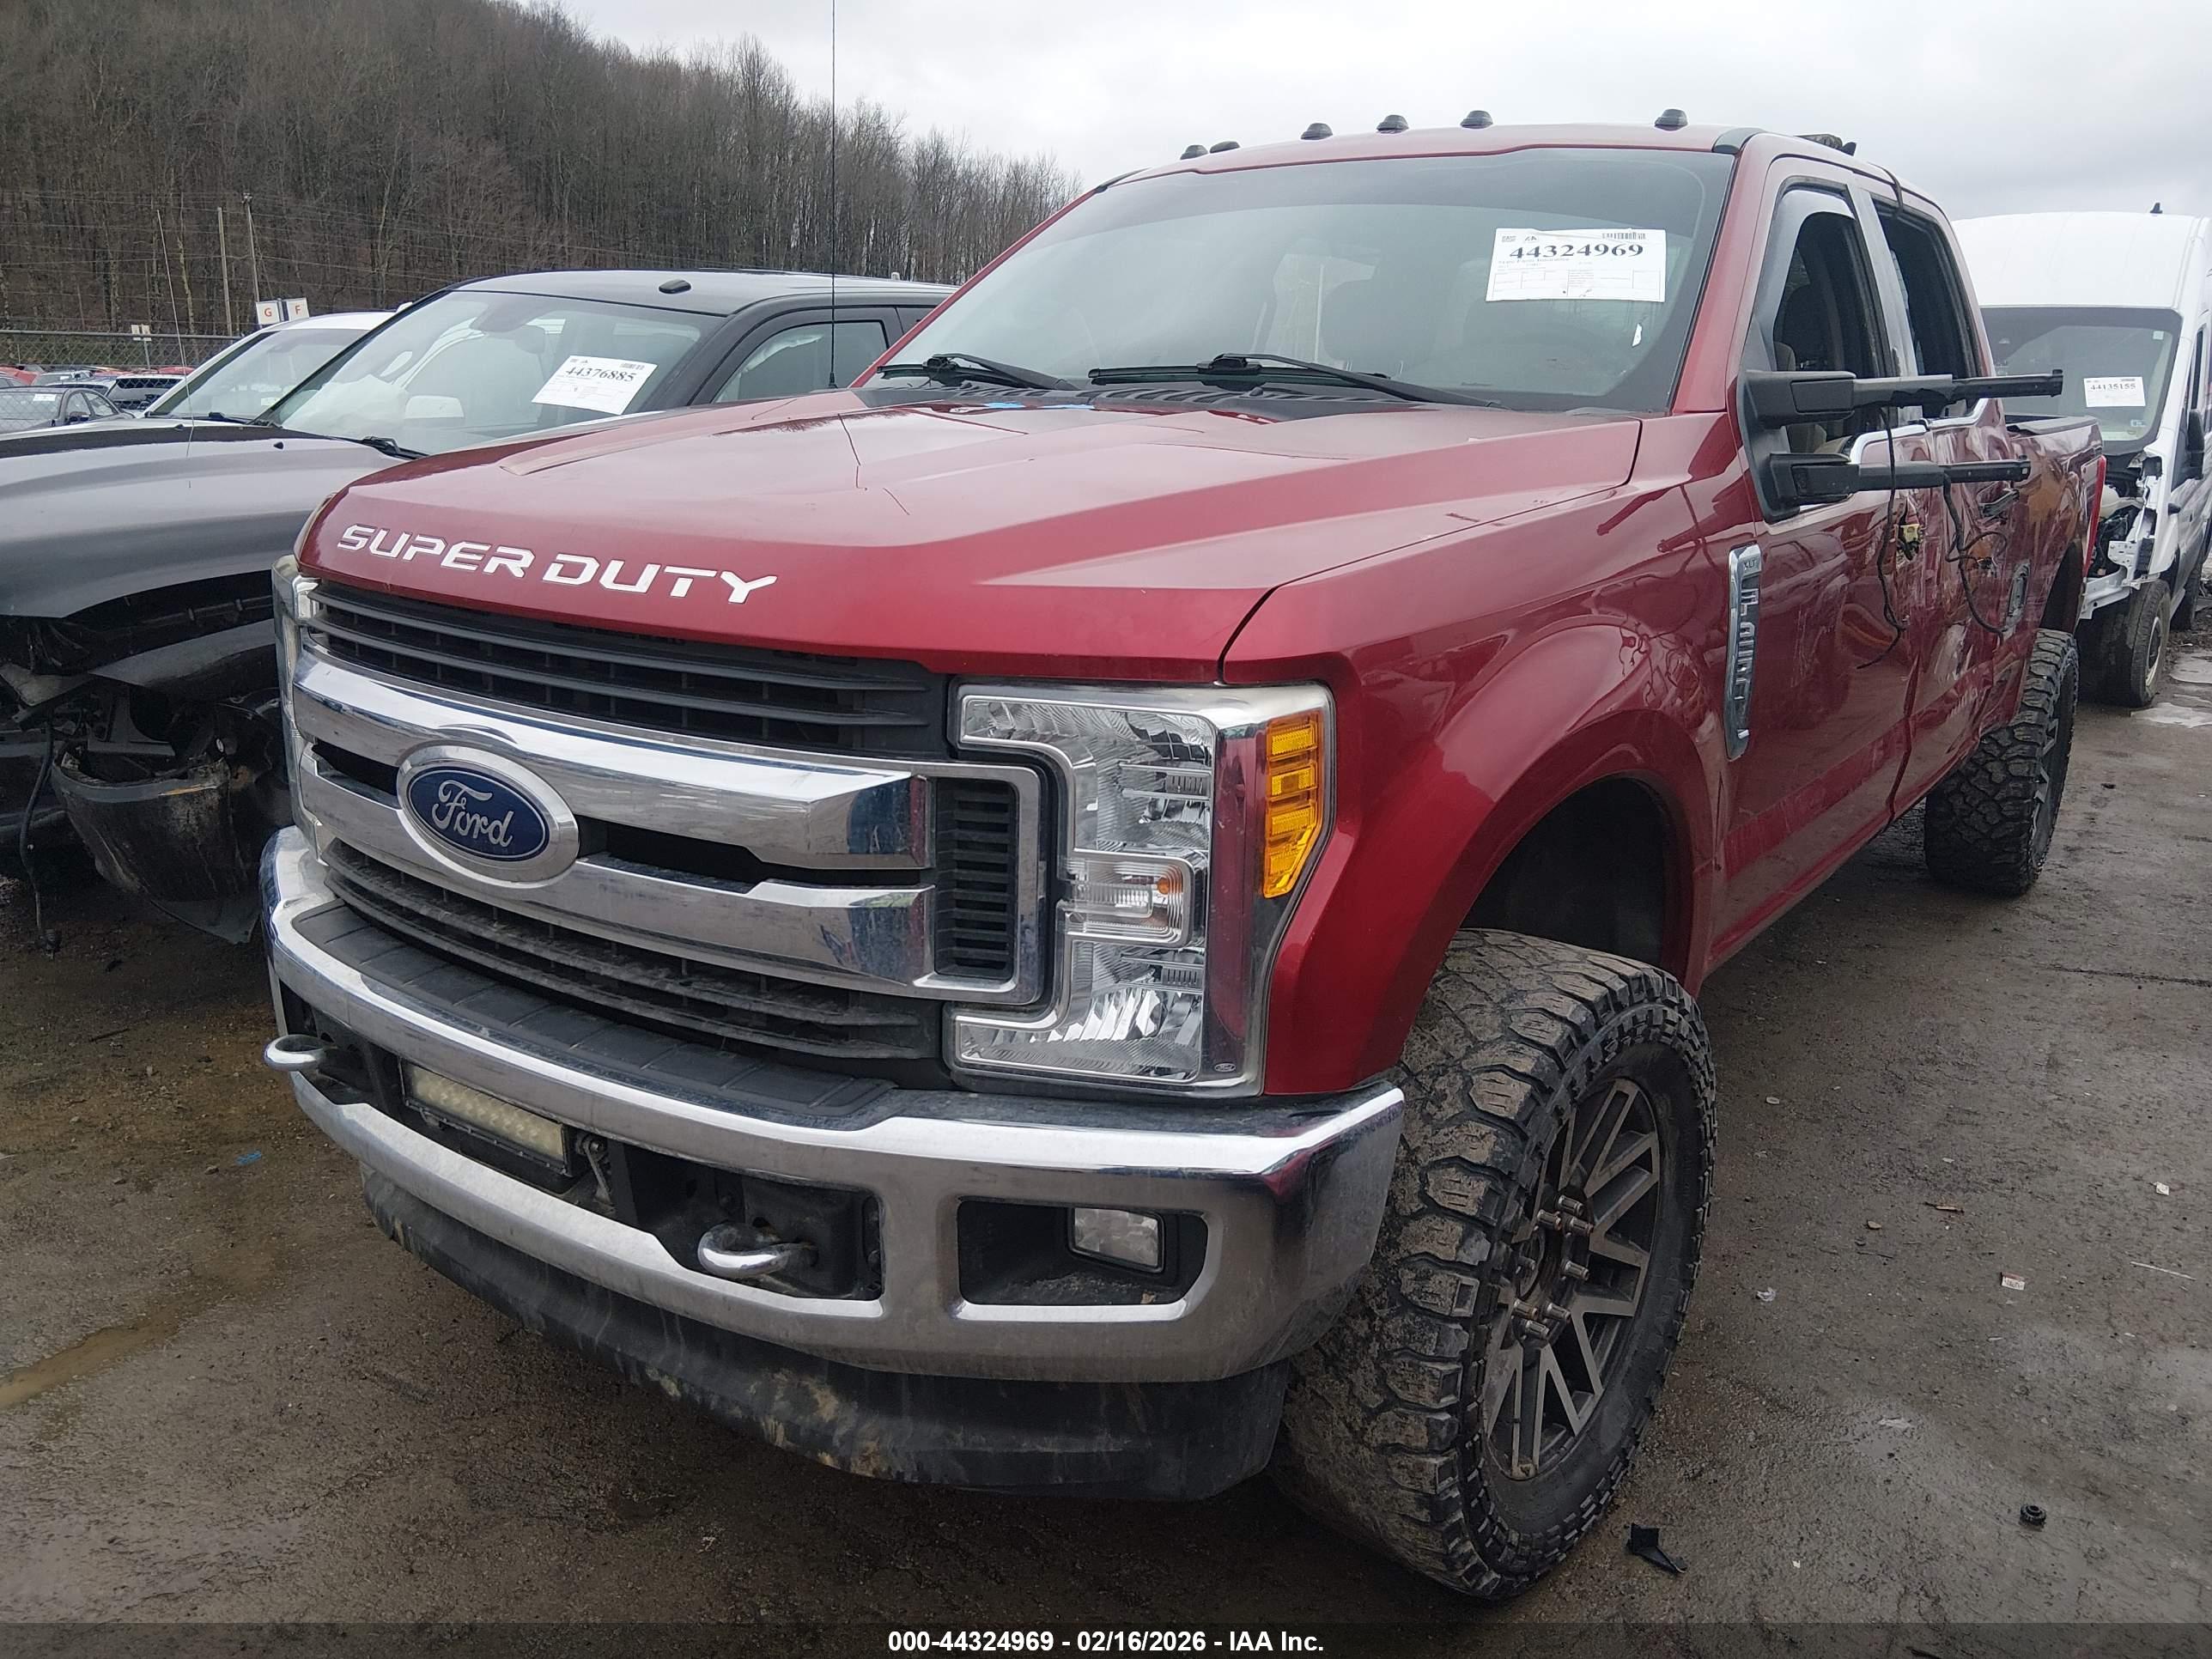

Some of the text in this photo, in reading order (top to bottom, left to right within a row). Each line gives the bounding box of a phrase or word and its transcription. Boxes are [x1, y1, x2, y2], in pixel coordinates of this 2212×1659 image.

[1509, 243, 1644, 258] 44324969
[264, 307, 273, 318] G
[295, 305, 302, 315] F
[565, 367, 638, 383] 44376885
[337, 524, 778, 605] SUPER DUTY
[431, 779, 515, 848] Ford
